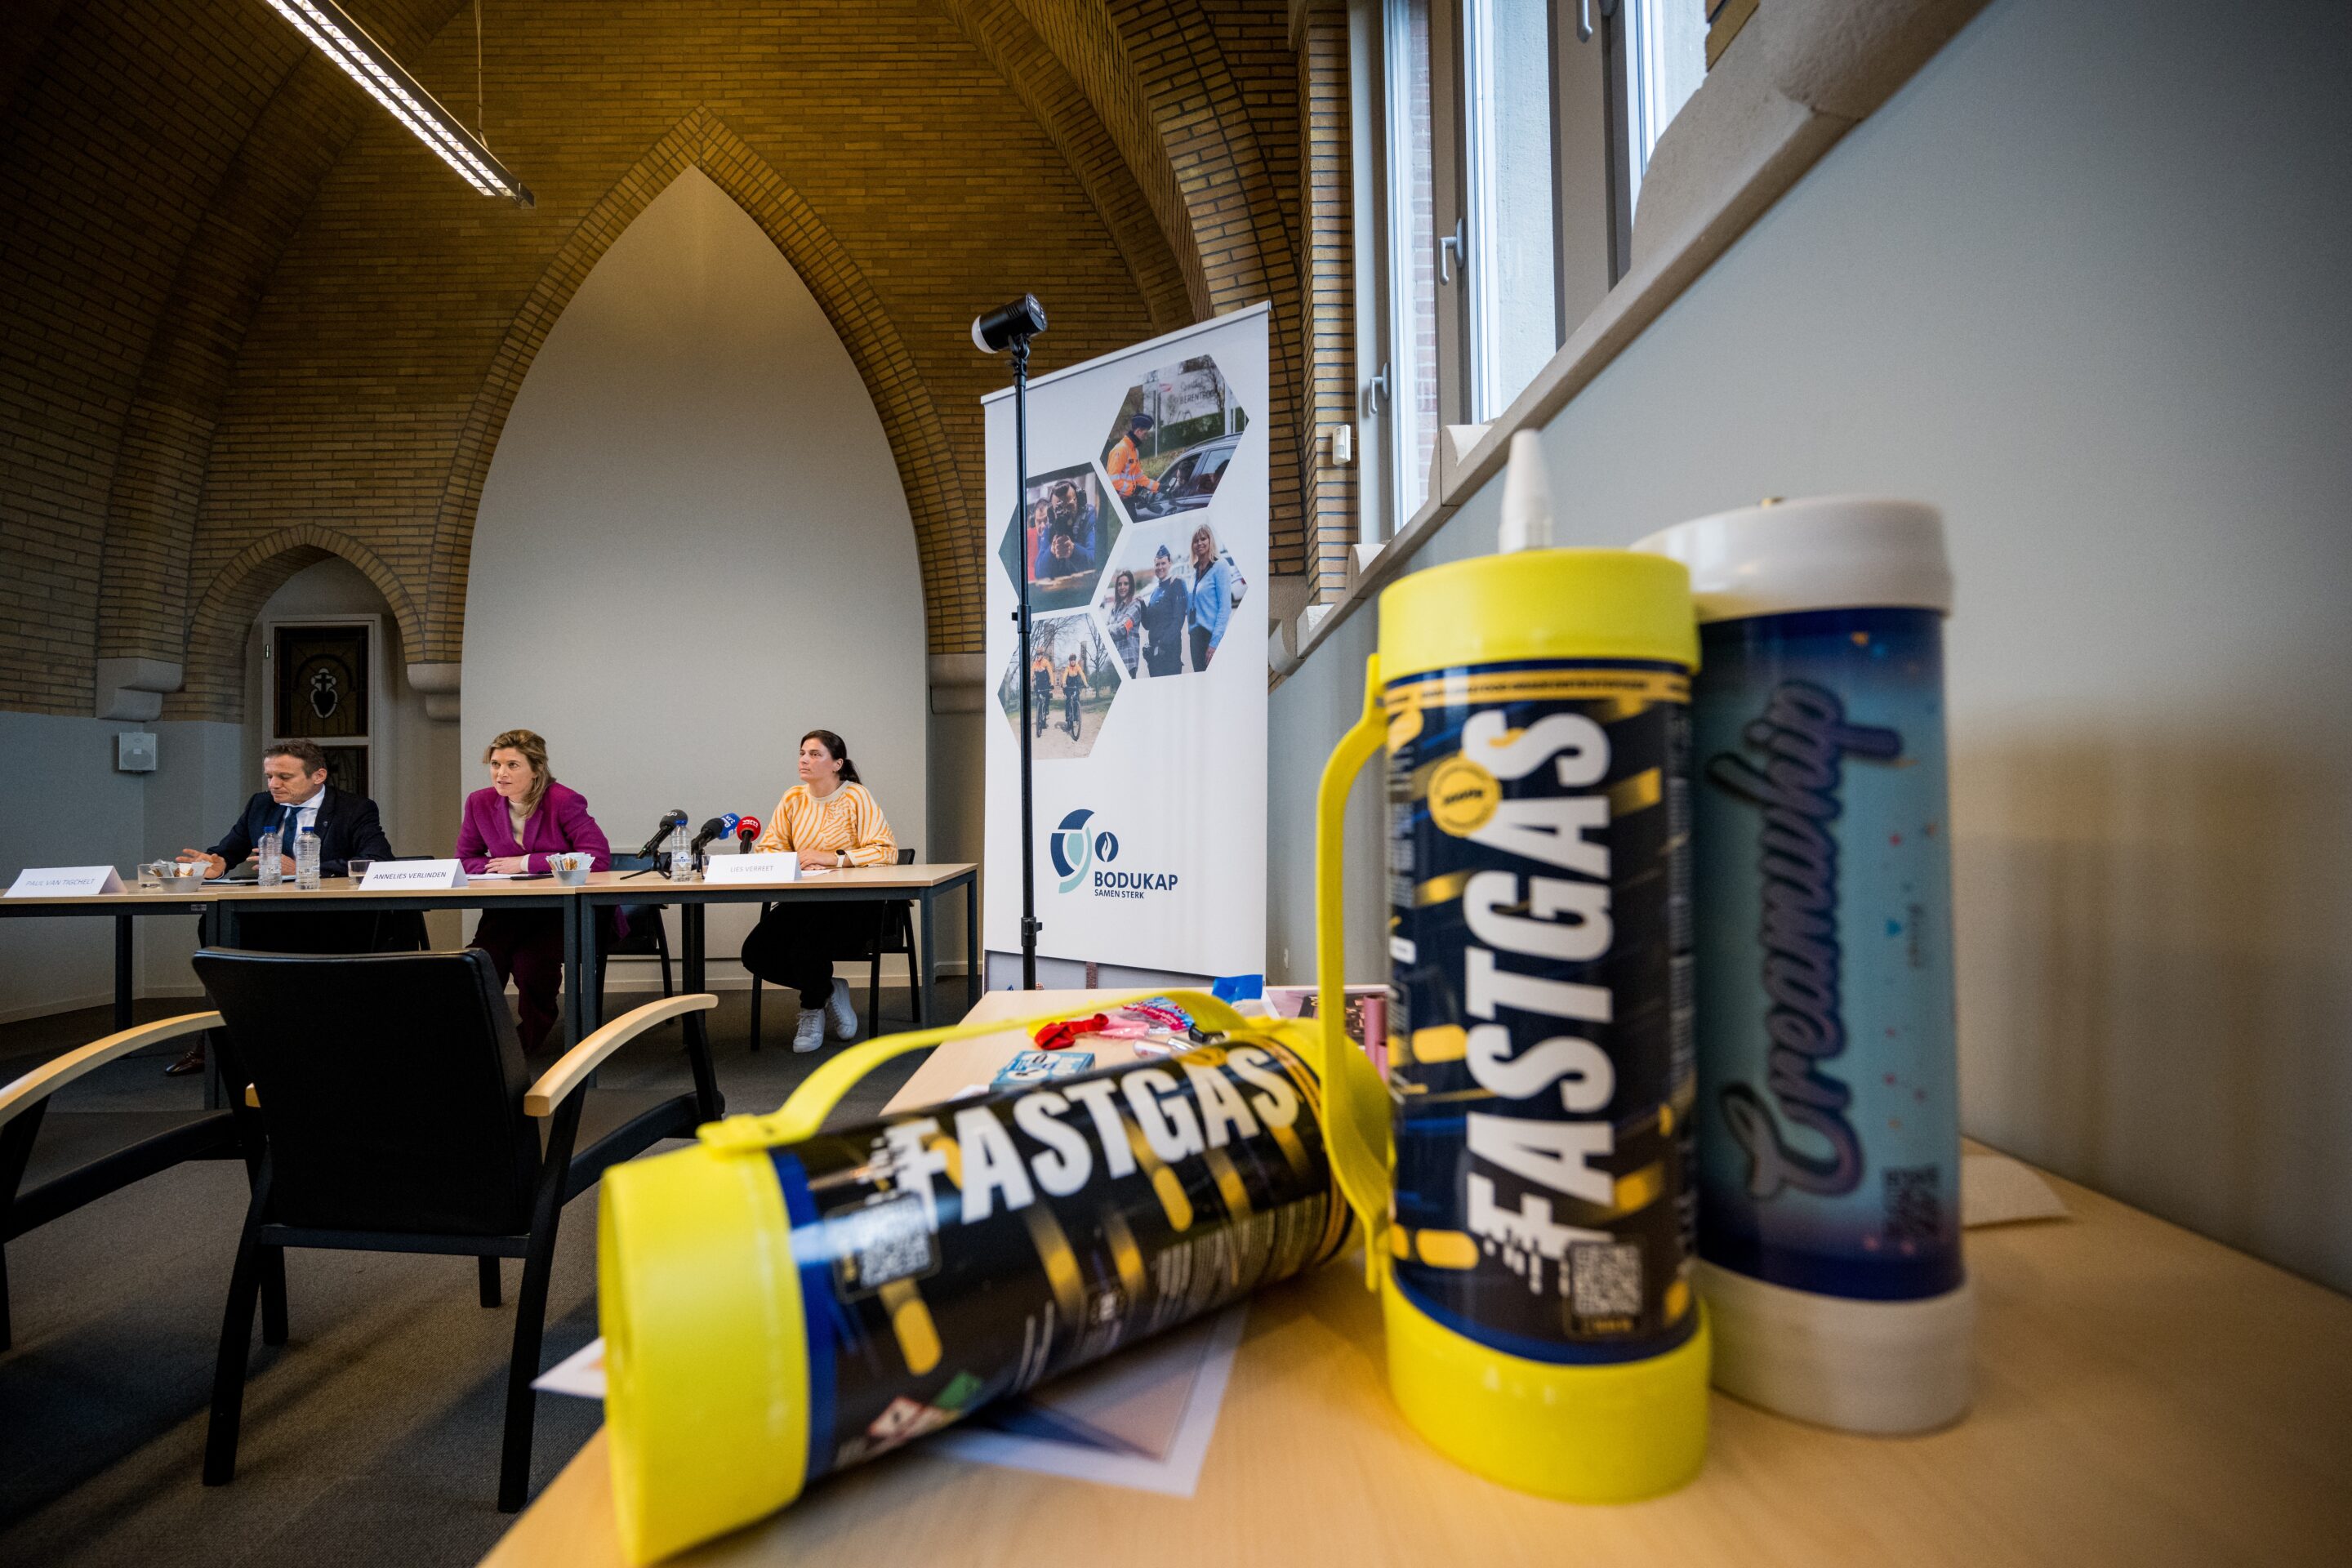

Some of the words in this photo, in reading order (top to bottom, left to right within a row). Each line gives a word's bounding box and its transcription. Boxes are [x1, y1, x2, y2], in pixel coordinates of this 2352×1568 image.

[1094, 871, 1178, 890] BODUKAP
[1094, 889, 1120, 898] SAMEN
[1121, 891, 1144, 899] STERK
[1709, 680, 1900, 1197] Creamwhip
[1463, 710, 1613, 1266] FASTGAS
[880, 1047, 1299, 1232] FASTGAS
